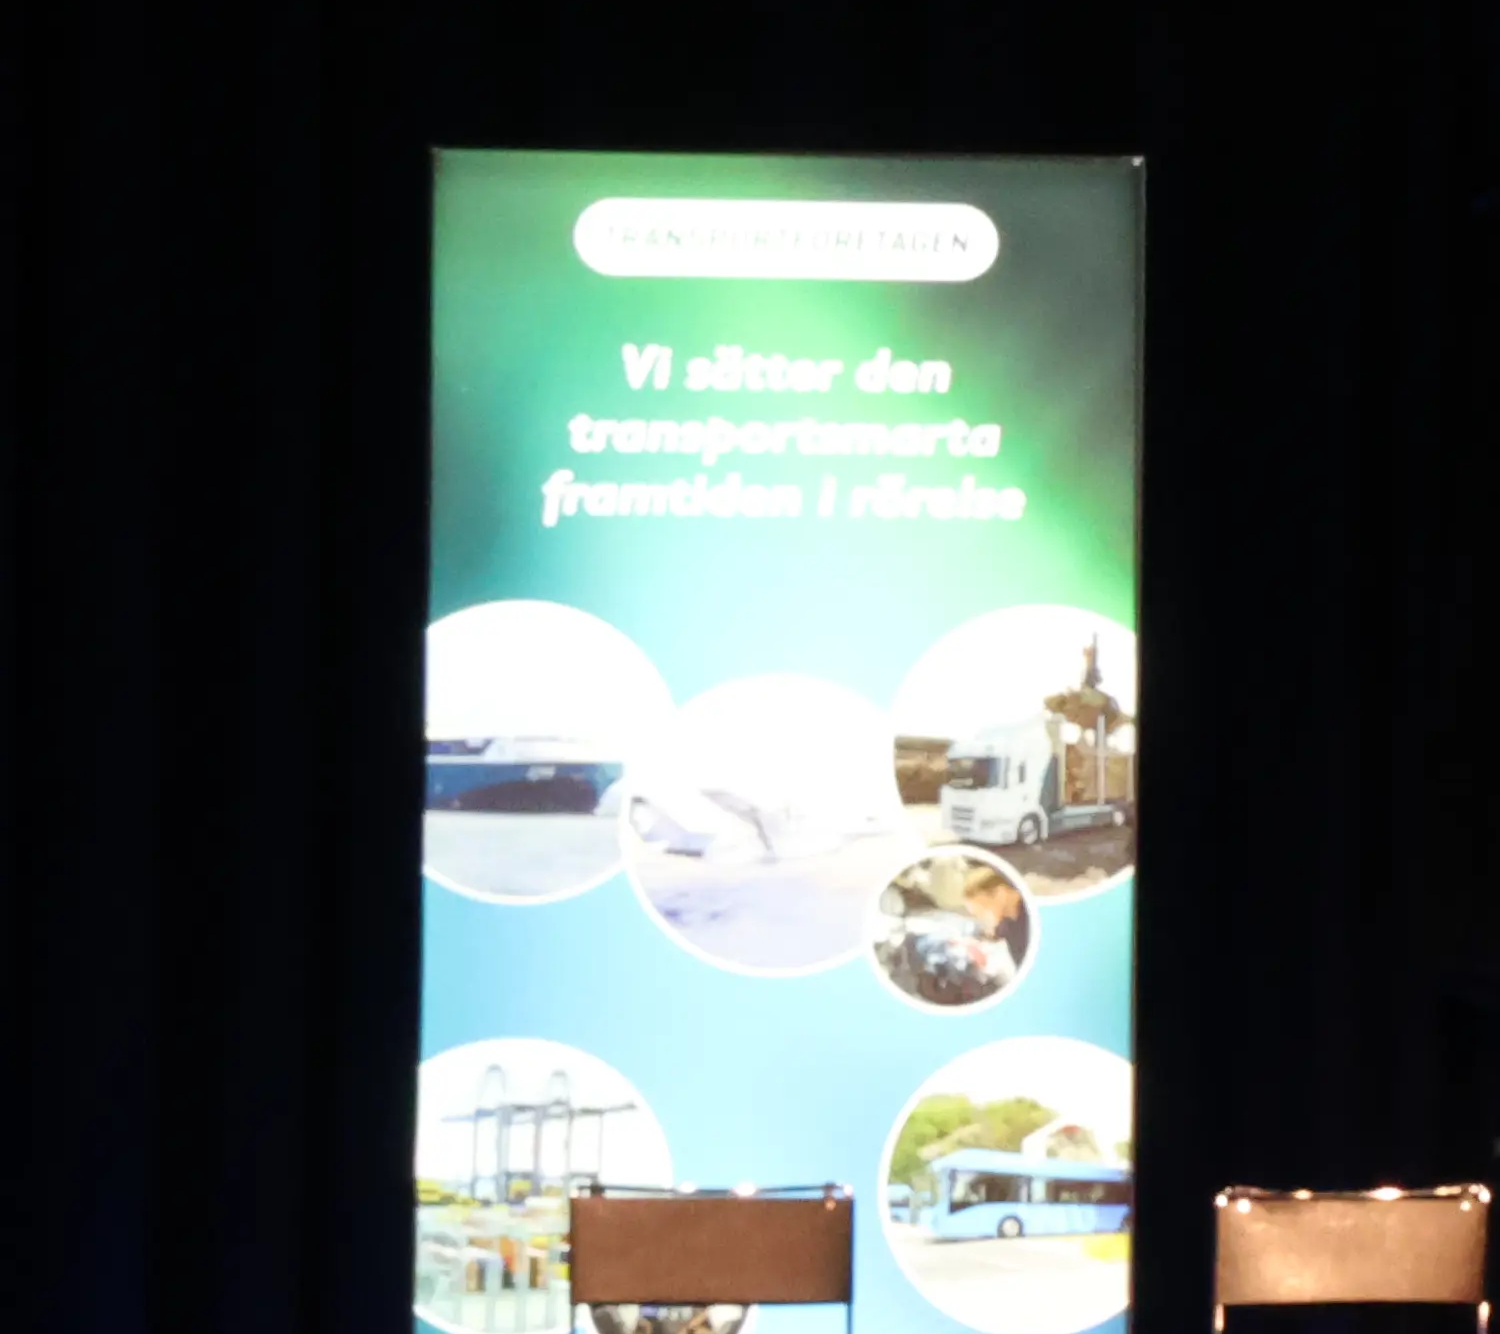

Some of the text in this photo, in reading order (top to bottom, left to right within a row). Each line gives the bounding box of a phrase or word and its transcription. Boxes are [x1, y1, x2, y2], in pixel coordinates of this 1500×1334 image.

[621, 343, 953, 394] Vi sätter den
[567, 412, 1003, 466] transportsmarta
[541, 469, 1027, 528] framtiden i rörelse
